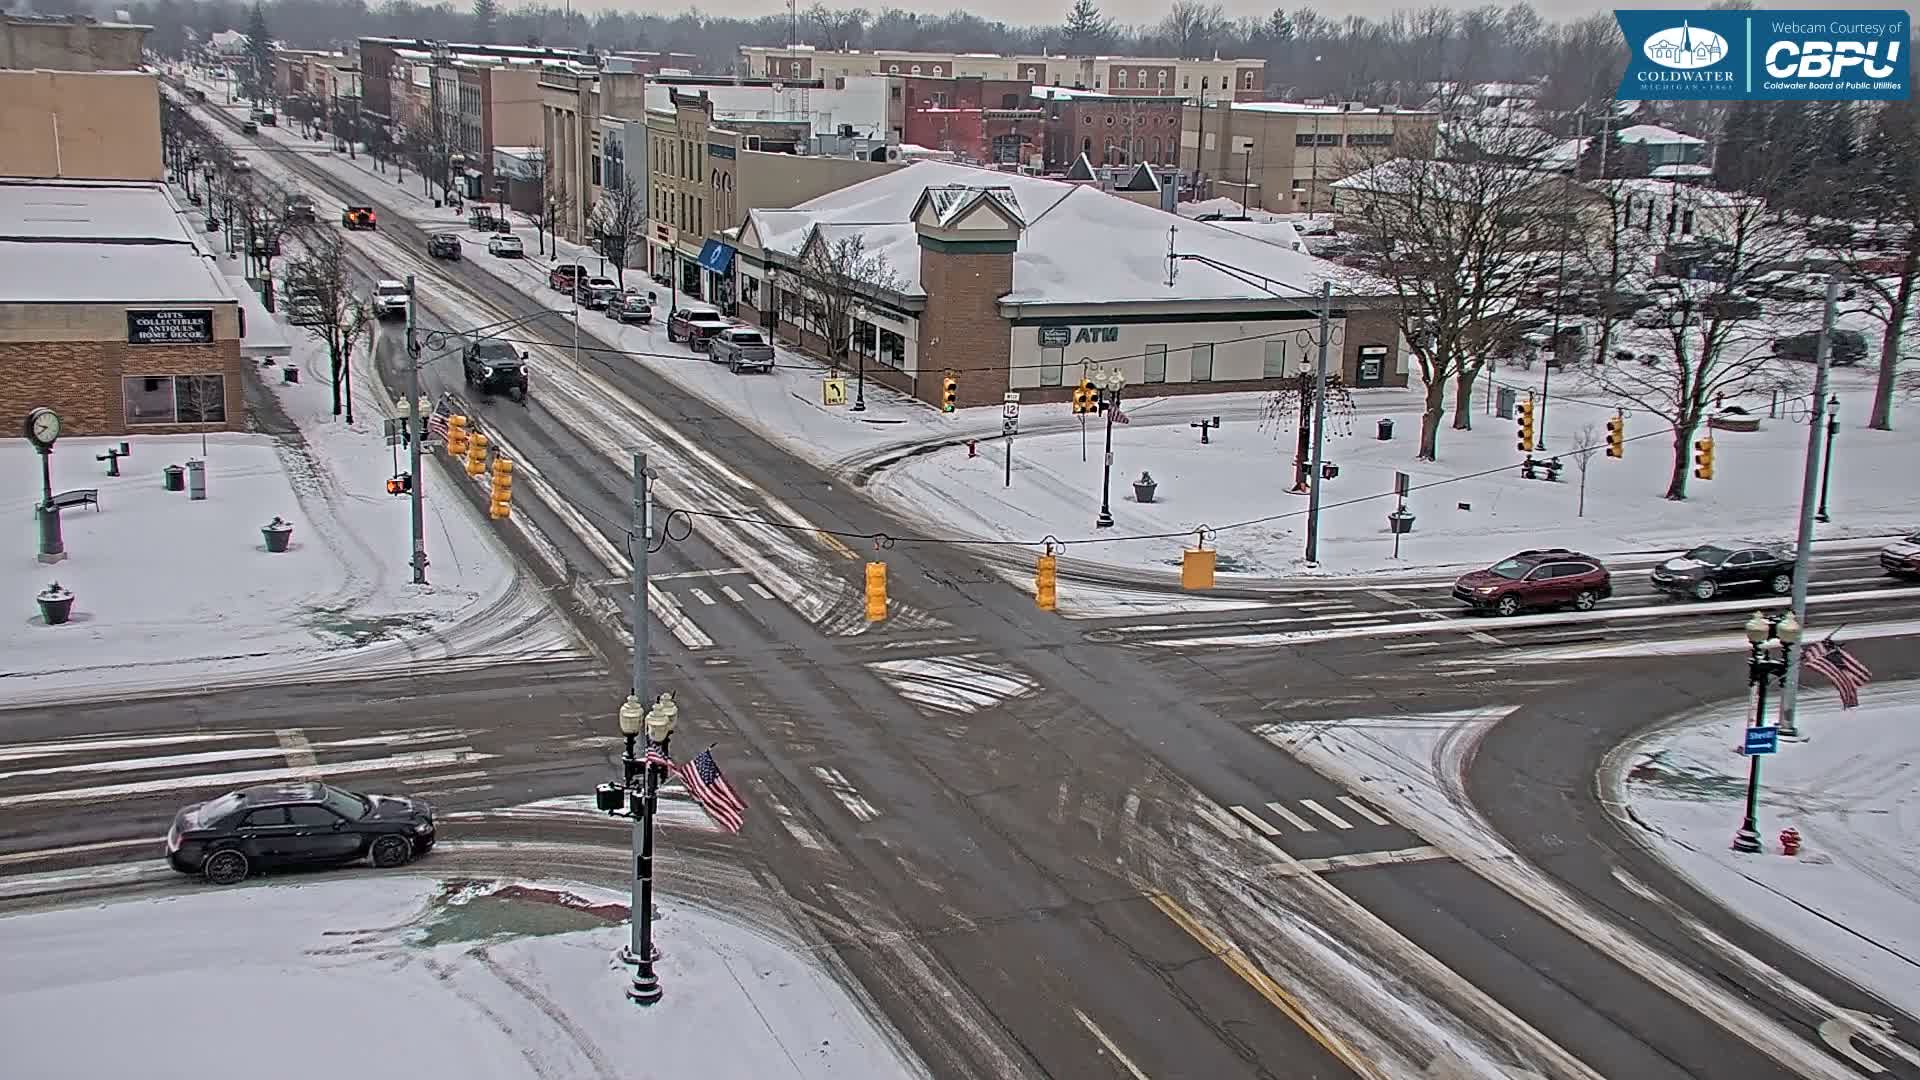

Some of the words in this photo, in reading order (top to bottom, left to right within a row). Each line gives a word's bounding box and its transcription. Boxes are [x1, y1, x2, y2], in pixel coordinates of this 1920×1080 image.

[136, 318, 204, 326] COLLECTIBLES
[148, 325, 194, 333] ANTIQUES
[139, 331, 168, 339] HOME
[1075, 326, 1119, 344] ATM
[1006, 405, 1016, 415] 12
